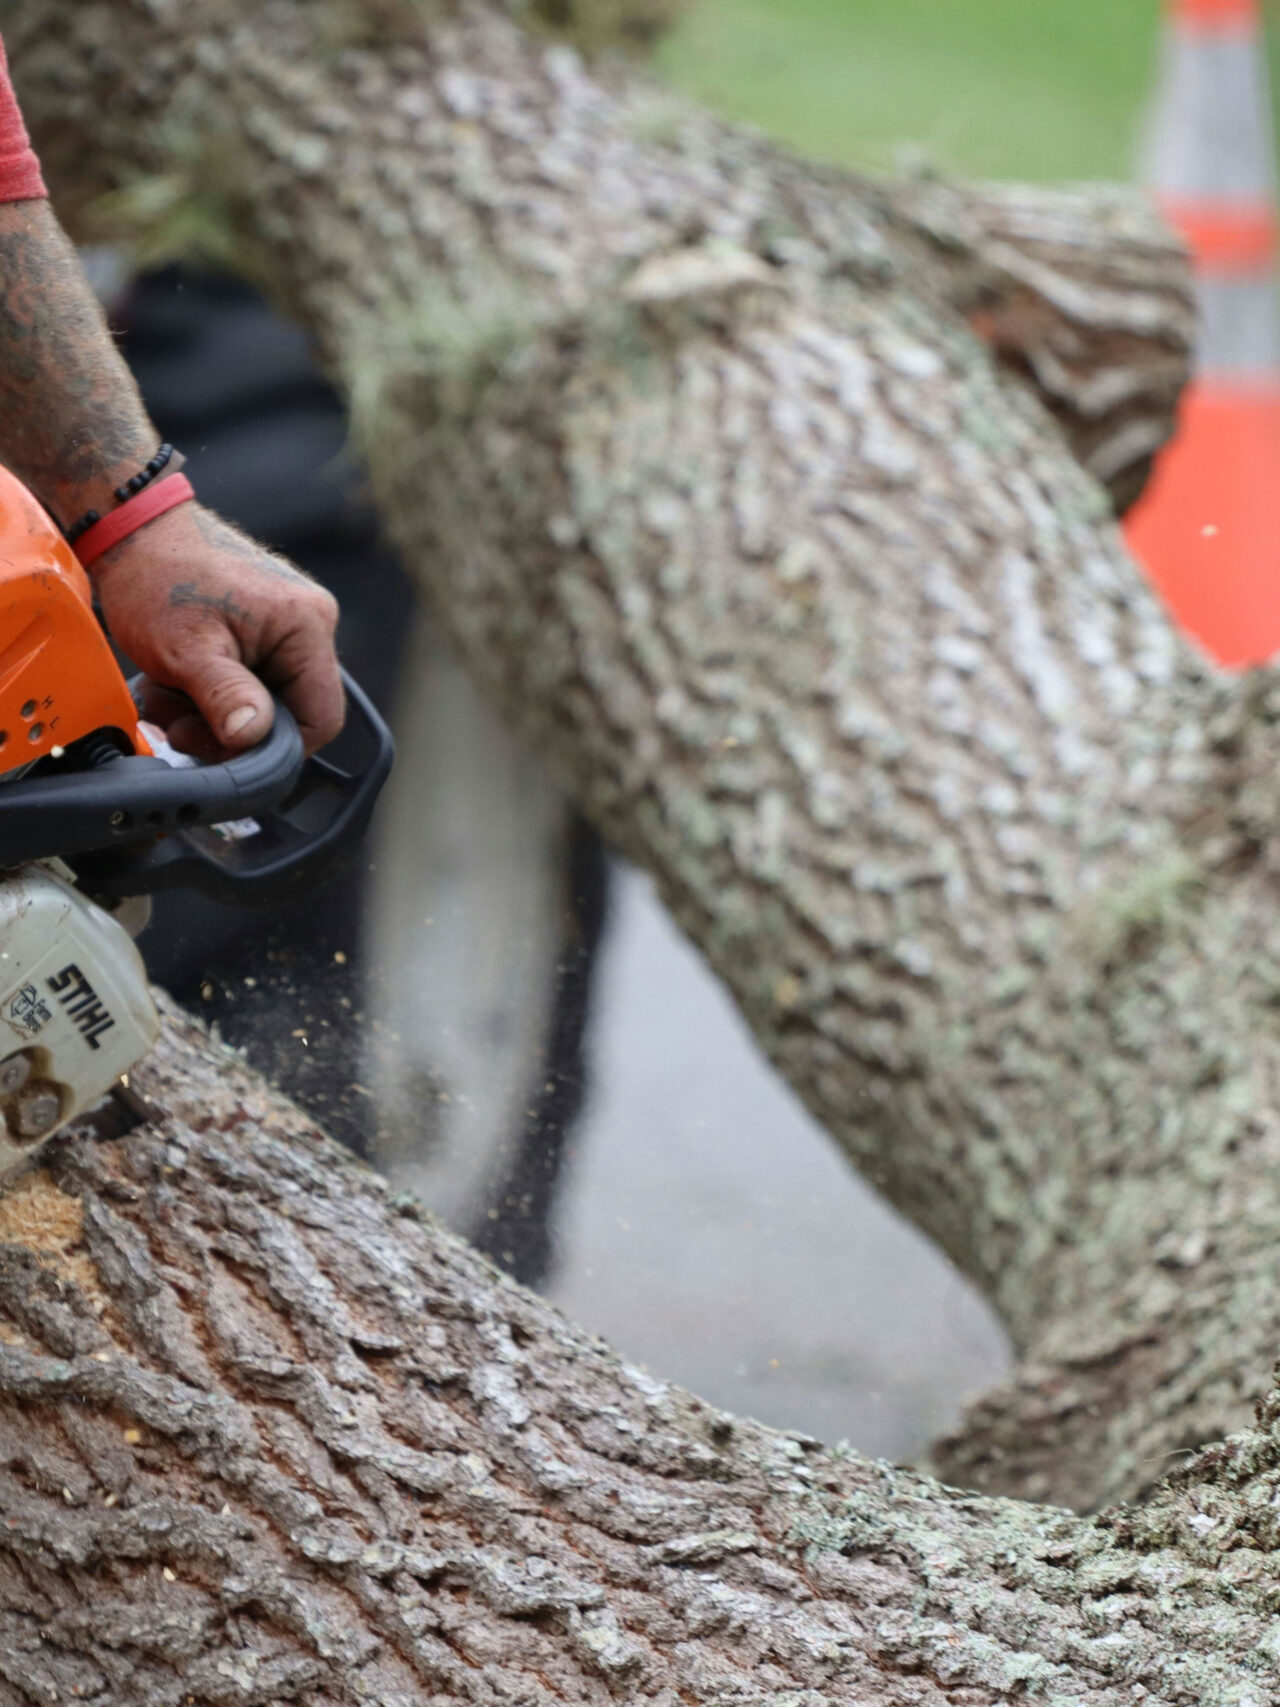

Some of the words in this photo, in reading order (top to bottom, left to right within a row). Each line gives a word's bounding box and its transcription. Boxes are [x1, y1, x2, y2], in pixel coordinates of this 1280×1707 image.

[42, 695, 54, 710] H
[49, 716, 60, 731] L
[45, 963, 115, 1050] STIHL
